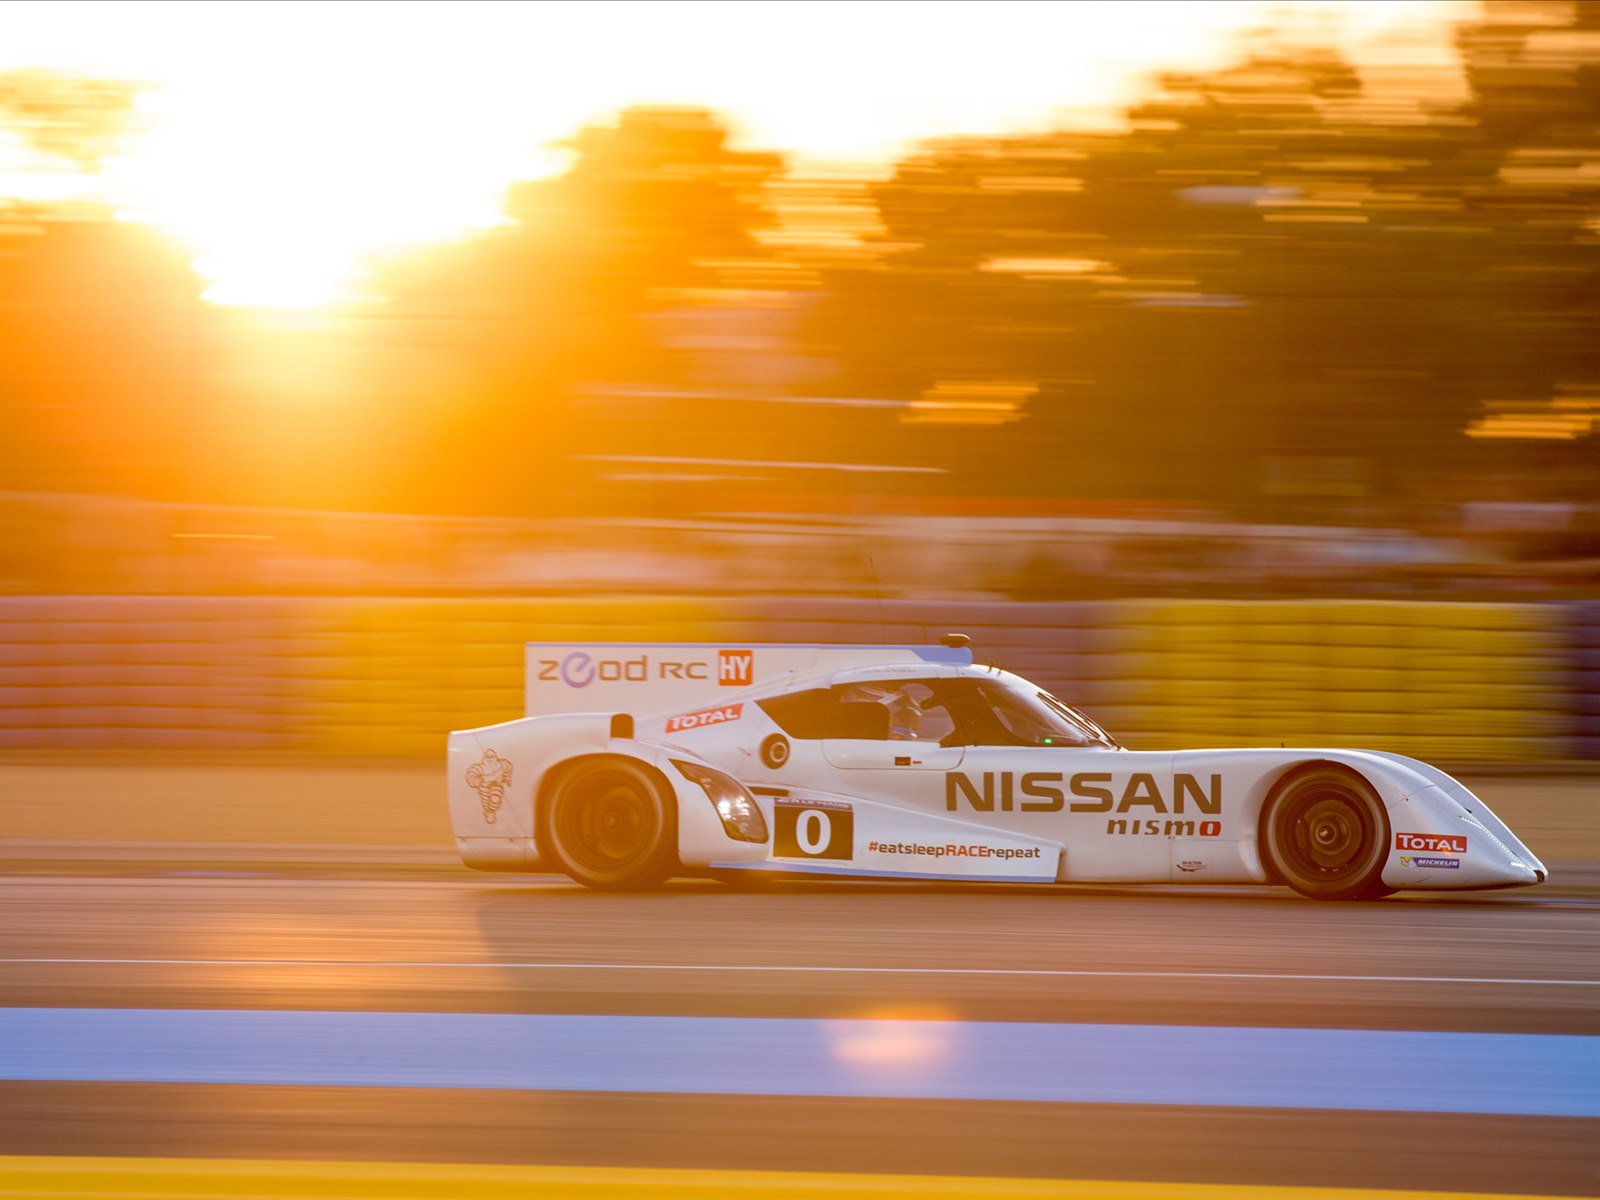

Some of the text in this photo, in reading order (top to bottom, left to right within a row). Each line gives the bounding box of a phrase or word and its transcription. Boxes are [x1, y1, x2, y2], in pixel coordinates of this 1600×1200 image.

[659, 662, 708, 680] RC
[720, 655, 750, 680] HY
[671, 707, 738, 731] TOTAL
[946, 771, 1222, 815] NISSAN
[796, 809, 832, 855] 0
[1107, 819, 1222, 837] nismo
[868, 841, 1041, 860] #eatsleepRACErepeat
[1398, 834, 1465, 852] TOTAL
[1417, 858, 1459, 867] MICHELIN
